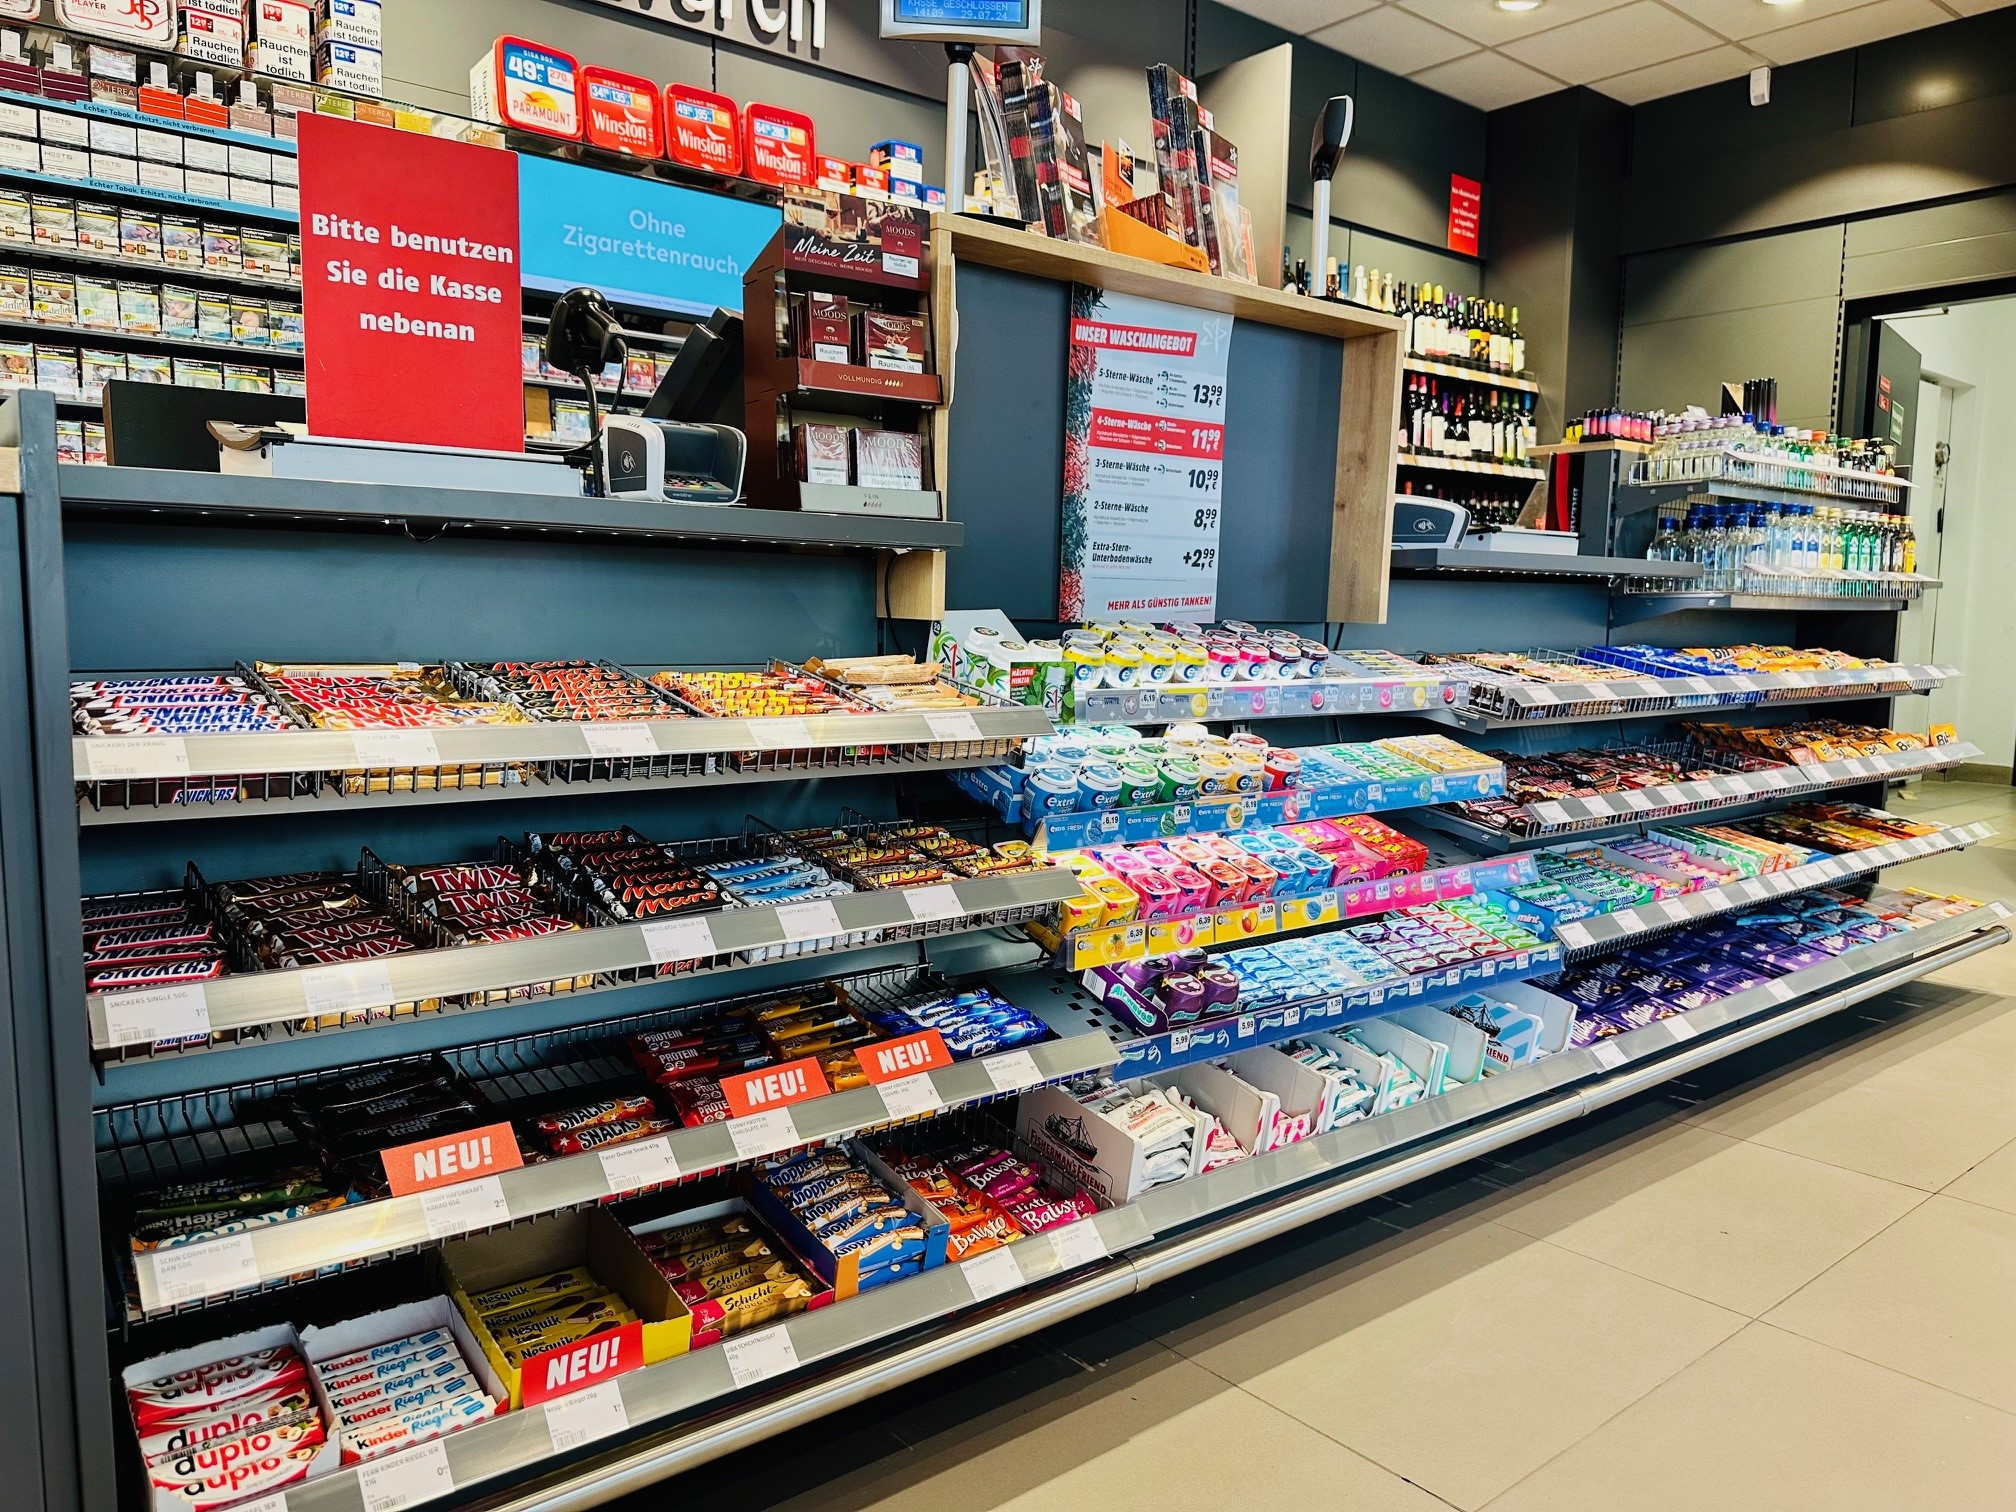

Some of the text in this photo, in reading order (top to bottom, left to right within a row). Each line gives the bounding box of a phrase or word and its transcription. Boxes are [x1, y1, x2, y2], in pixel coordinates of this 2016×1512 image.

[914, 7, 1008, 21] 14:09 29.07.24
[943, 0, 1008, 12] GESCHLOSSEN
[335, 19, 379, 37] Rauchen
[191, 36, 240, 55] Rauchen
[259, 38, 309, 58] Rauchen
[266, 64, 305, 80] tödlich
[278, 55, 293, 66] ist
[336, 67, 380, 85] Rauchen
[106, 85, 136, 97] TEREA
[83, 104, 218, 136] Echter Tabak. Erhitzt, nicht verbrannt.
[367, 107, 393, 119] TEREA
[512, 100, 571, 127] PARAMOUNT
[591, 109, 647, 141] Winston
[676, 126, 727, 156] Winston
[753, 144, 801, 176] Winston
[628, 209, 686, 239] Ohne
[885, 225, 916, 237] MOODS
[311, 213, 514, 265] Bitte benutzen
[562, 223, 744, 278] Zigarettenrauch.
[792, 235, 841, 258] Meine
[842, 243, 875, 264] Zeit
[326, 260, 368, 286] Sie
[378, 267, 420, 293] die
[430, 275, 503, 304] Kasse
[812, 308, 847, 320] MOODS
[359, 311, 476, 342] nebenan
[1074, 324, 1194, 353] UNSER WASCHANGEBOT
[838, 374, 882, 385] VOLLMUNDIG
[1098, 368, 1154, 386] 5-Sterne-Wäsche
[1096, 415, 1152, 432] 4-Sterne-Wäsche
[809, 431, 846, 442] MOODS
[1095, 458, 1150, 473] 3-Sterne-Wäsche
[1093, 500, 1149, 514] 2-Sterne-Wäsche
[1092, 541, 1132, 552] Extra-Stern-
[1092, 552, 1153, 565] Unterbodenwäsche
[1106, 596, 1213, 611] MEHR ALS GÜNSTIG TANKEN!
[175, 788, 235, 804] SNICKERS
[1046, 796, 1075, 811] extra
[1094, 792, 1120, 807] extra
[1067, 824, 1084, 832] FRESH
[1142, 816, 1159, 824] FRESH
[551, 829, 625, 852] Mars
[419, 864, 522, 893] TWIX
[635, 889, 718, 919] Mars
[467, 913, 576, 942] TWIX
[1516, 913, 1540, 925] mint
[281, 917, 396, 950] TWIX
[298, 934, 416, 965] TWIX
[109, 991, 188, 1010] SNICKERS SINGLE 50G
[1111, 983, 1157, 1027] Airwaves
[643, 1029, 684, 1045] PROTEIN
[658, 1048, 700, 1065] PROTEIN
[875, 1039, 933, 1076] NEU!
[1486, 1046, 1509, 1063] RIEND
[744, 1068, 808, 1108] NEU!
[626, 1097, 649, 1108] original
[558, 1100, 617, 1131] SNACKS
[577, 1118, 642, 1151] SNACKS
[413, 1135, 493, 1183] NEU!
[601, 1153, 615, 1161] Fazer
[615, 1149, 633, 1159] Dumle
[633, 1145, 649, 1154] Snack
[1030, 1129, 1107, 1195] FISHERMAN'S FRIEND
[765, 1157, 823, 1188] Knoppers
[966, 1156, 1020, 1191] Balisto
[424, 1184, 484, 1206] CORNY HAFERKRAFT
[786, 1173, 846, 1207] Knoppers
[800, 1188, 859, 1224] Knoppers
[948, 1216, 1007, 1256] Balisto
[159, 1240, 242, 1266] SCHW CORNY BIG SCHO
[160, 1259, 193, 1274] BAN 50G
[706, 1262, 759, 1291] Schicht-
[477, 1283, 530, 1306] Nesquik
[719, 1277, 754, 1292] NOUGAT
[723, 1284, 778, 1313] Schicht-
[738, 1297, 773, 1312] NOUGAT
[485, 1306, 539, 1330] Nesquik
[506, 1314, 562, 1338] Nesquik
[725, 1331, 777, 1355] VIBA SCHICHTNOUGAT
[377, 1348, 422, 1376] Riegel
[545, 1336, 621, 1391] NEU!
[394, 1384, 441, 1411] Riegel
[410, 1408, 458, 1434] Riegel
[174, 1431, 273, 1477] duplo
[362, 1469, 380, 1479] FERR
[379, 1459, 405, 1473] KINDER
[404, 1451, 428, 1463] RIEGEL
[182, 1455, 282, 1496] duplo
